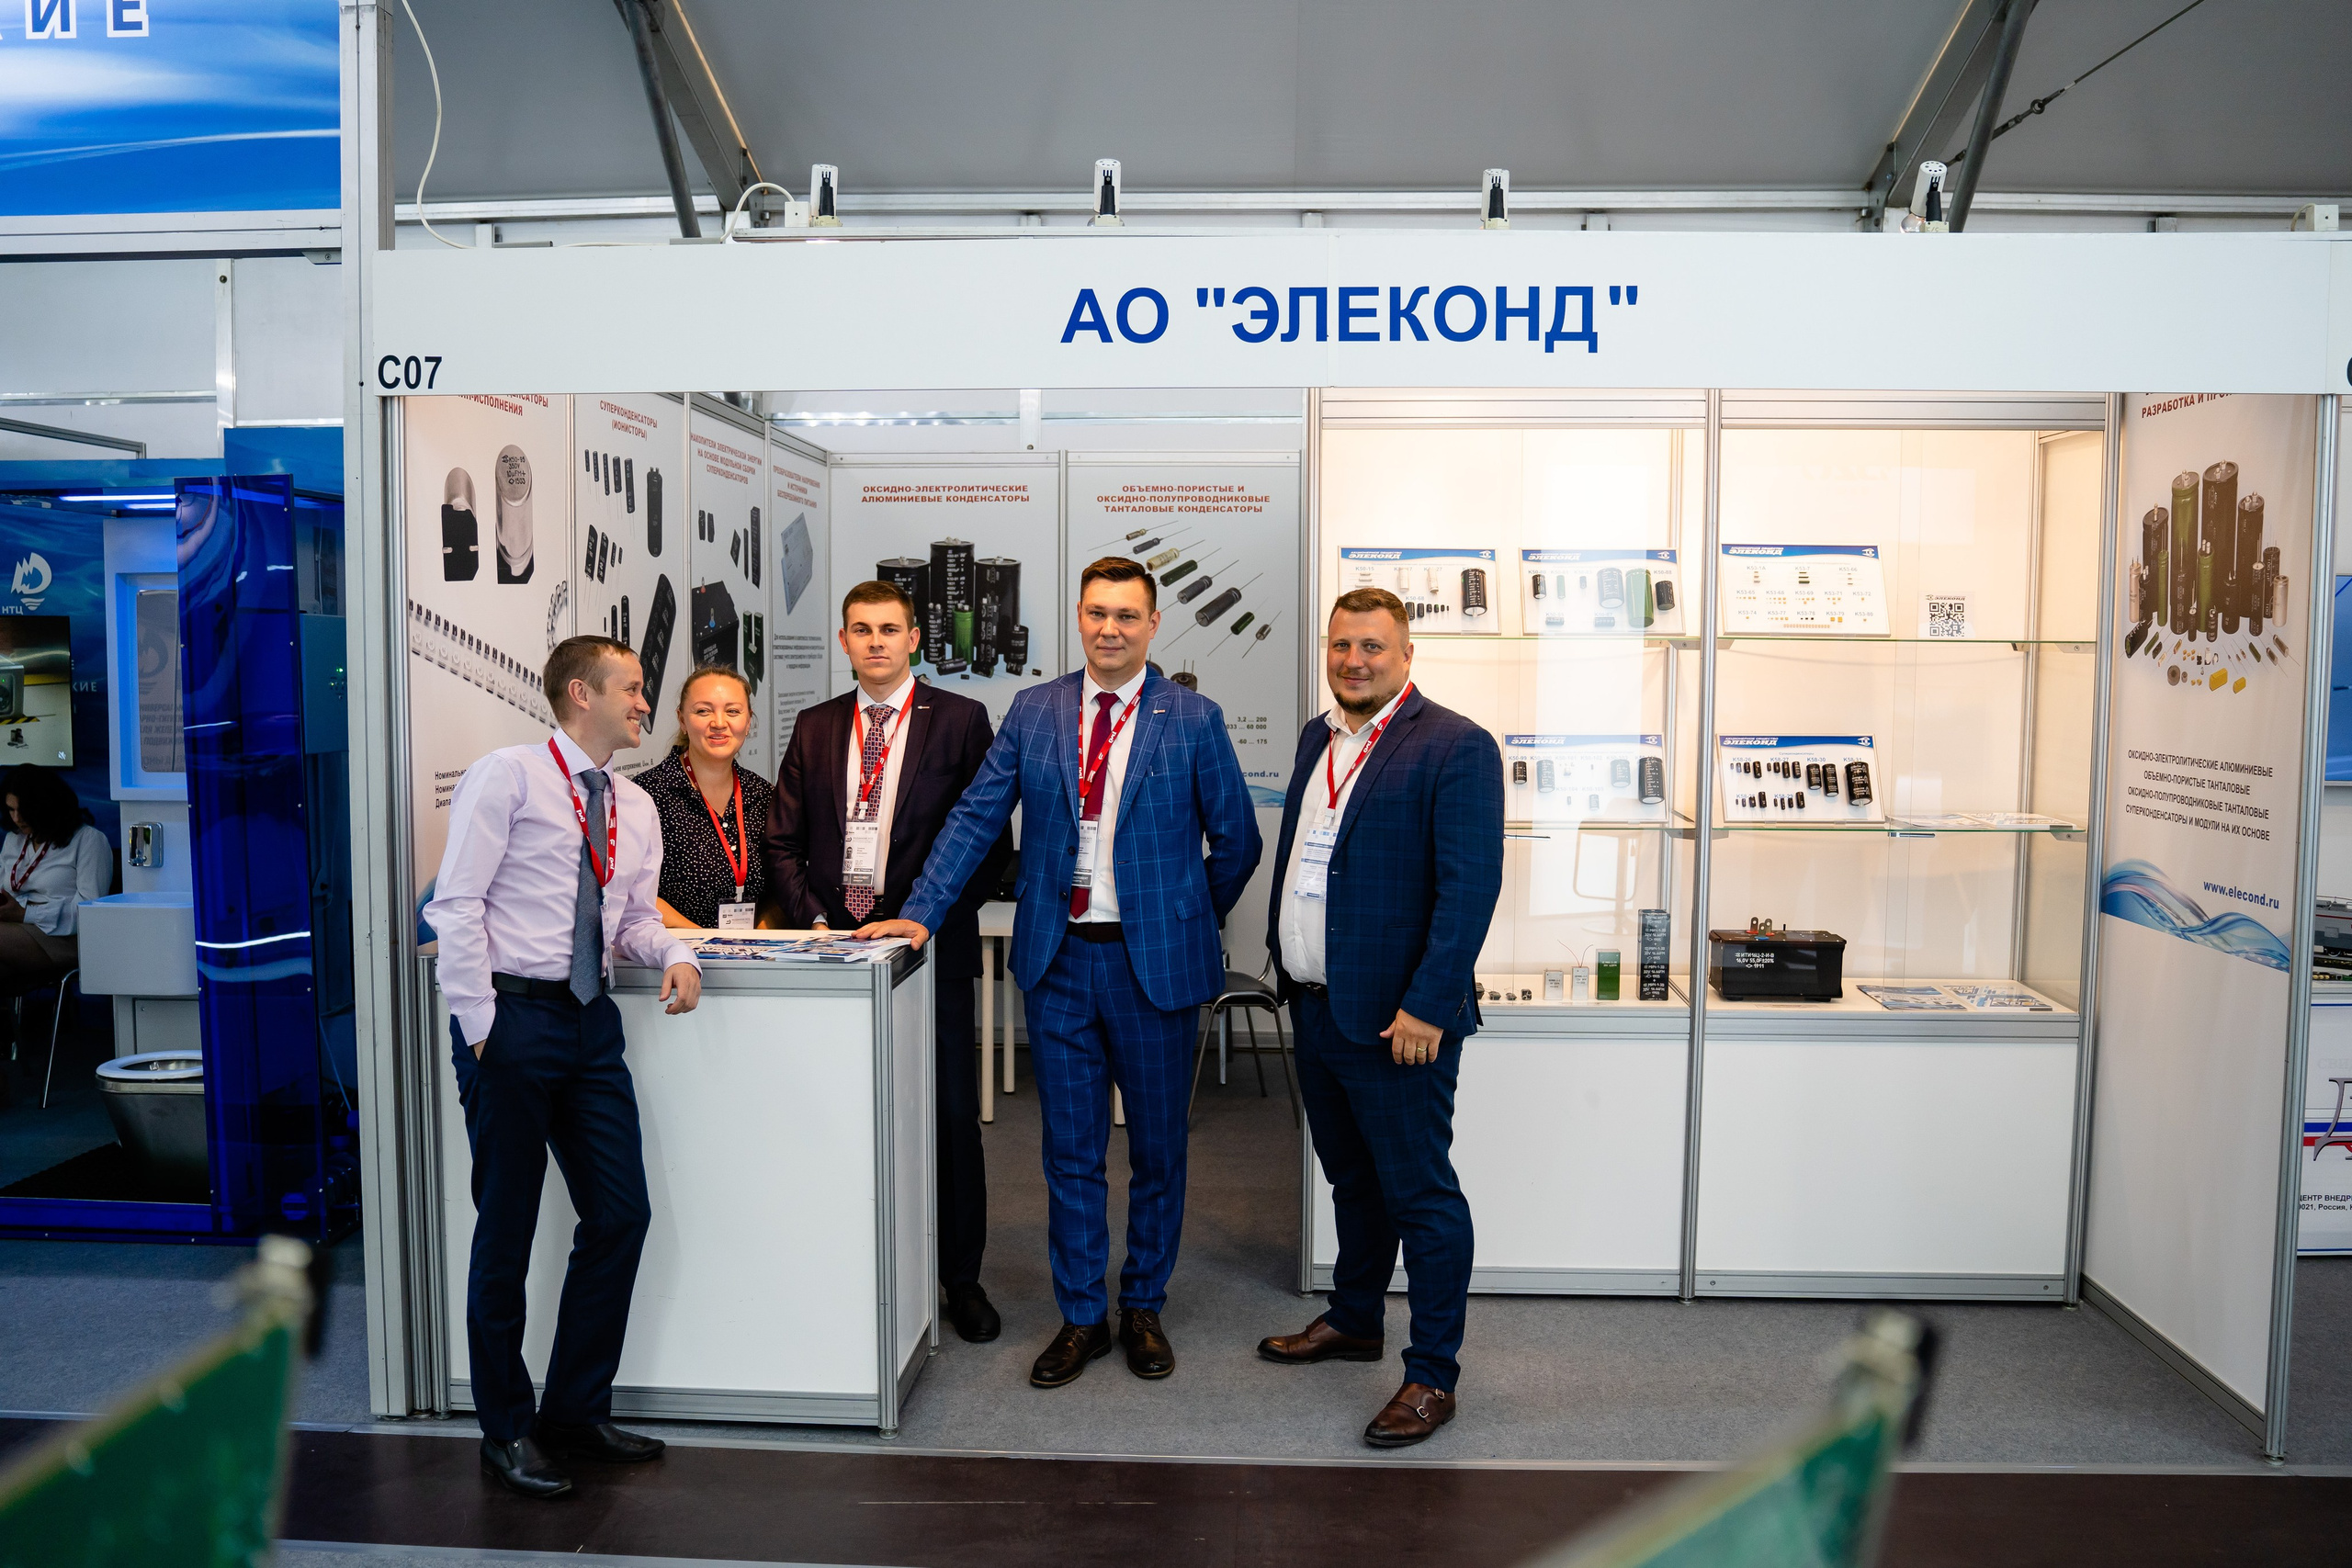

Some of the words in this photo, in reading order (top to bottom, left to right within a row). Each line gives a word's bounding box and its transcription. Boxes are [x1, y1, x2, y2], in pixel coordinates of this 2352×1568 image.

[1061, 287, 1170, 344] АО
[1196, 285, 1639, 354] "ЭЛЕКОНД"
[599, 400, 658, 429] СУПЕРКОНДЕНСАТОРЫ
[2142, 394, 2195, 419] РАЗРАБОТКА
[861, 495, 943, 503] АЛЮМИНИЕВЫЕ
[945, 495, 1030, 503] КОНДЕНСАТОРЫ
[863, 485, 1028, 493] ОКСИДНО-ЭЛЕКТРОЛИТИЧЕСКИЕ
[1097, 495, 1271, 503] ОКСИДНО-ПОЛУПРОВОДНИКОВЫЕ
[1178, 505, 1262, 513] КОНДЕНСАТОРЫ
[2, 606, 24, 615] НТЦ
[435, 769, 467, 780] Номинальн
[2128, 750, 2218, 771] ОКСИДНО-ЭЛЕКТРОЛИТИЧЕСКИЕ
[2220, 761, 2273, 778] АЛЮМИНИЕВЫЕ
[2143, 770, 2206, 789] ОБЪЕМНО-ПОРИСТЫЕ
[2207, 779, 2250, 795] ТАНТАЛОВЫЕ
[2128, 786, 2222, 812] ОКСИДНО-ПОЛУПРОВОДНИКОВЫЕ
[2224, 802, 2269, 819] ТАНТАЛОВЫЕ
[2125, 804, 2188, 826] СУПЕРКОНДЕНСАТОРЫ
[2188, 817, 2193, 826] И
[2194, 817, 2220, 832] МОДУЛИ
[2221, 821, 2230, 833] НА
[2232, 824, 2240, 836] ИХ
[2242, 826, 2270, 841] ОСНОВЕ
[2203, 880, 2279, 909] www.elecond.ru
